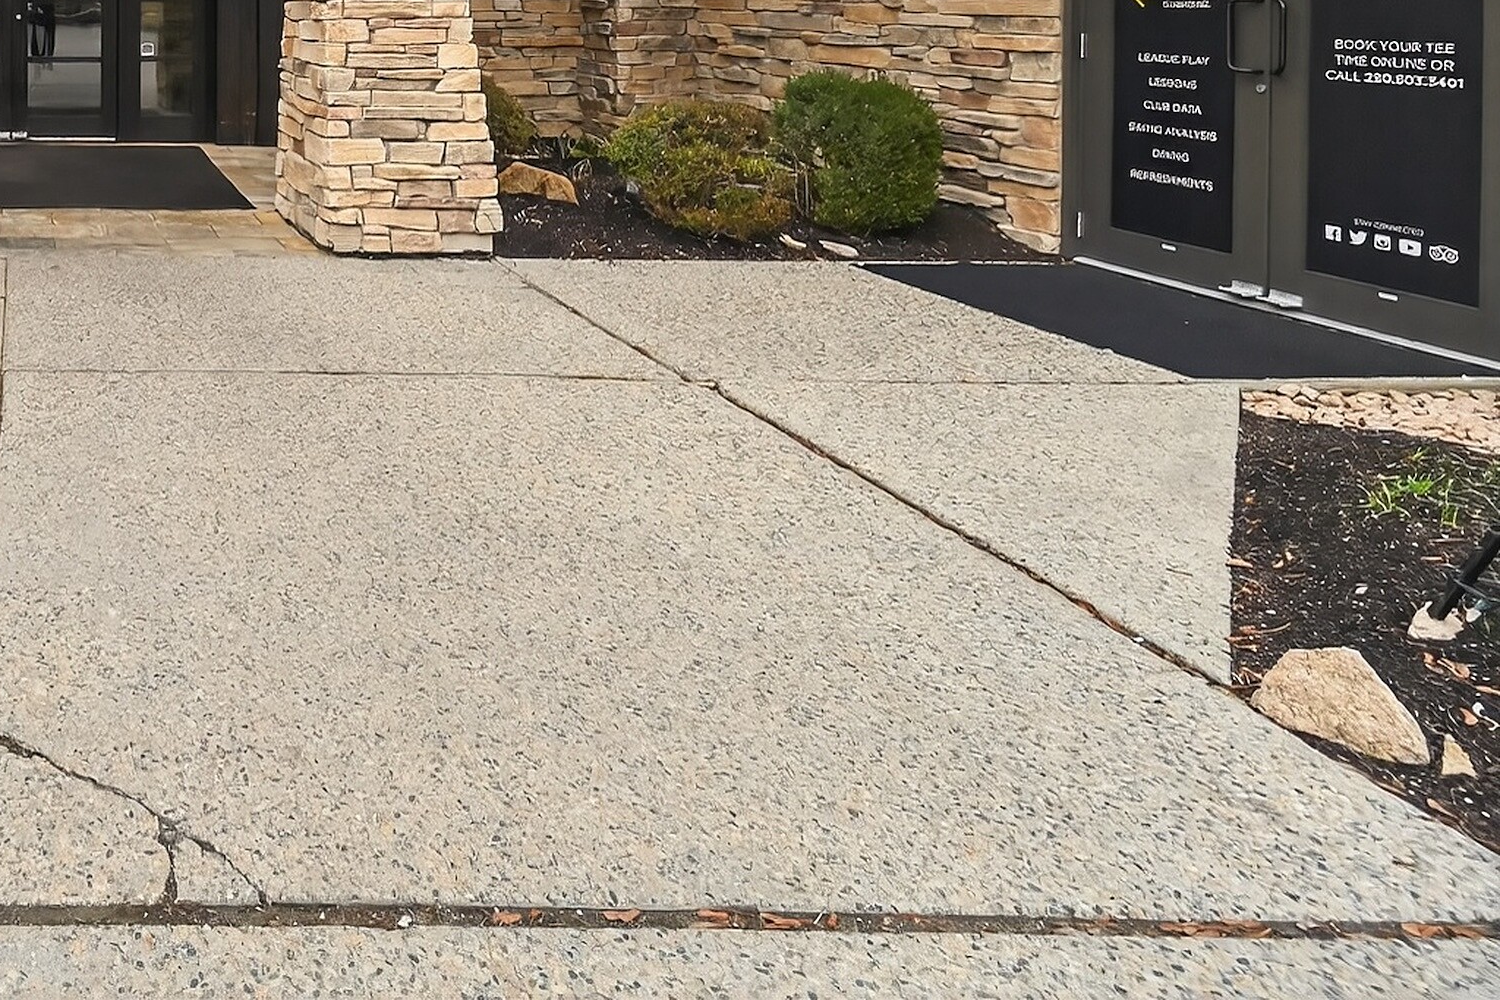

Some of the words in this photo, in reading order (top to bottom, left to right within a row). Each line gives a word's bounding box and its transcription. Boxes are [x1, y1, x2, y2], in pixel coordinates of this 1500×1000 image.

[1334, 38, 1378, 50] BOOK
[1379, 40, 1422, 53] YOUR
[1425, 42, 1456, 54] TEE
[1334, 53, 1368, 67] TIME
[1370, 56, 1428, 71] ONLINE
[1430, 59, 1456, 72] OR
[1324, 69, 1362, 83] CALL
